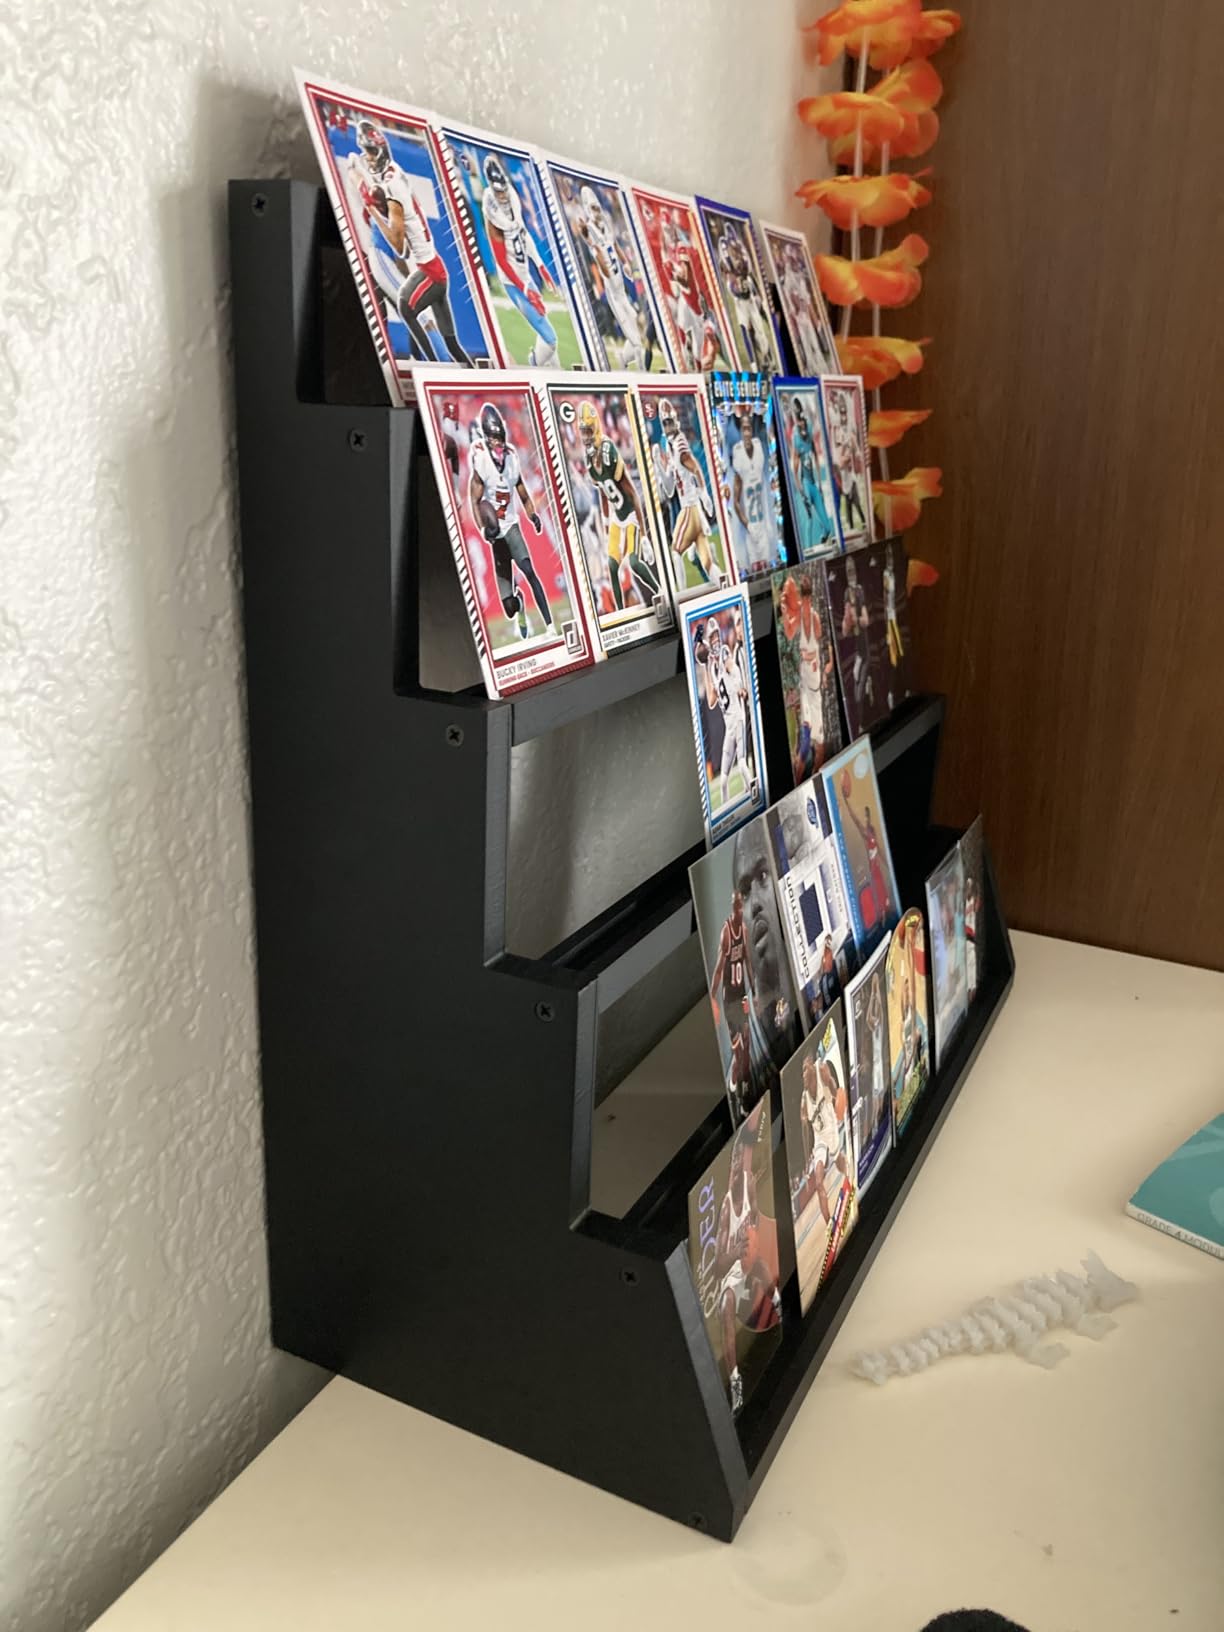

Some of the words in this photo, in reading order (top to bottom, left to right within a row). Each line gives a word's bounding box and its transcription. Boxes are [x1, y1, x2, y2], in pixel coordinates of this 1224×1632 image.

[496, 665, 517, 680] BUCKY
[516, 658, 538, 672] IRVING
[731, 961, 743, 986] 10
